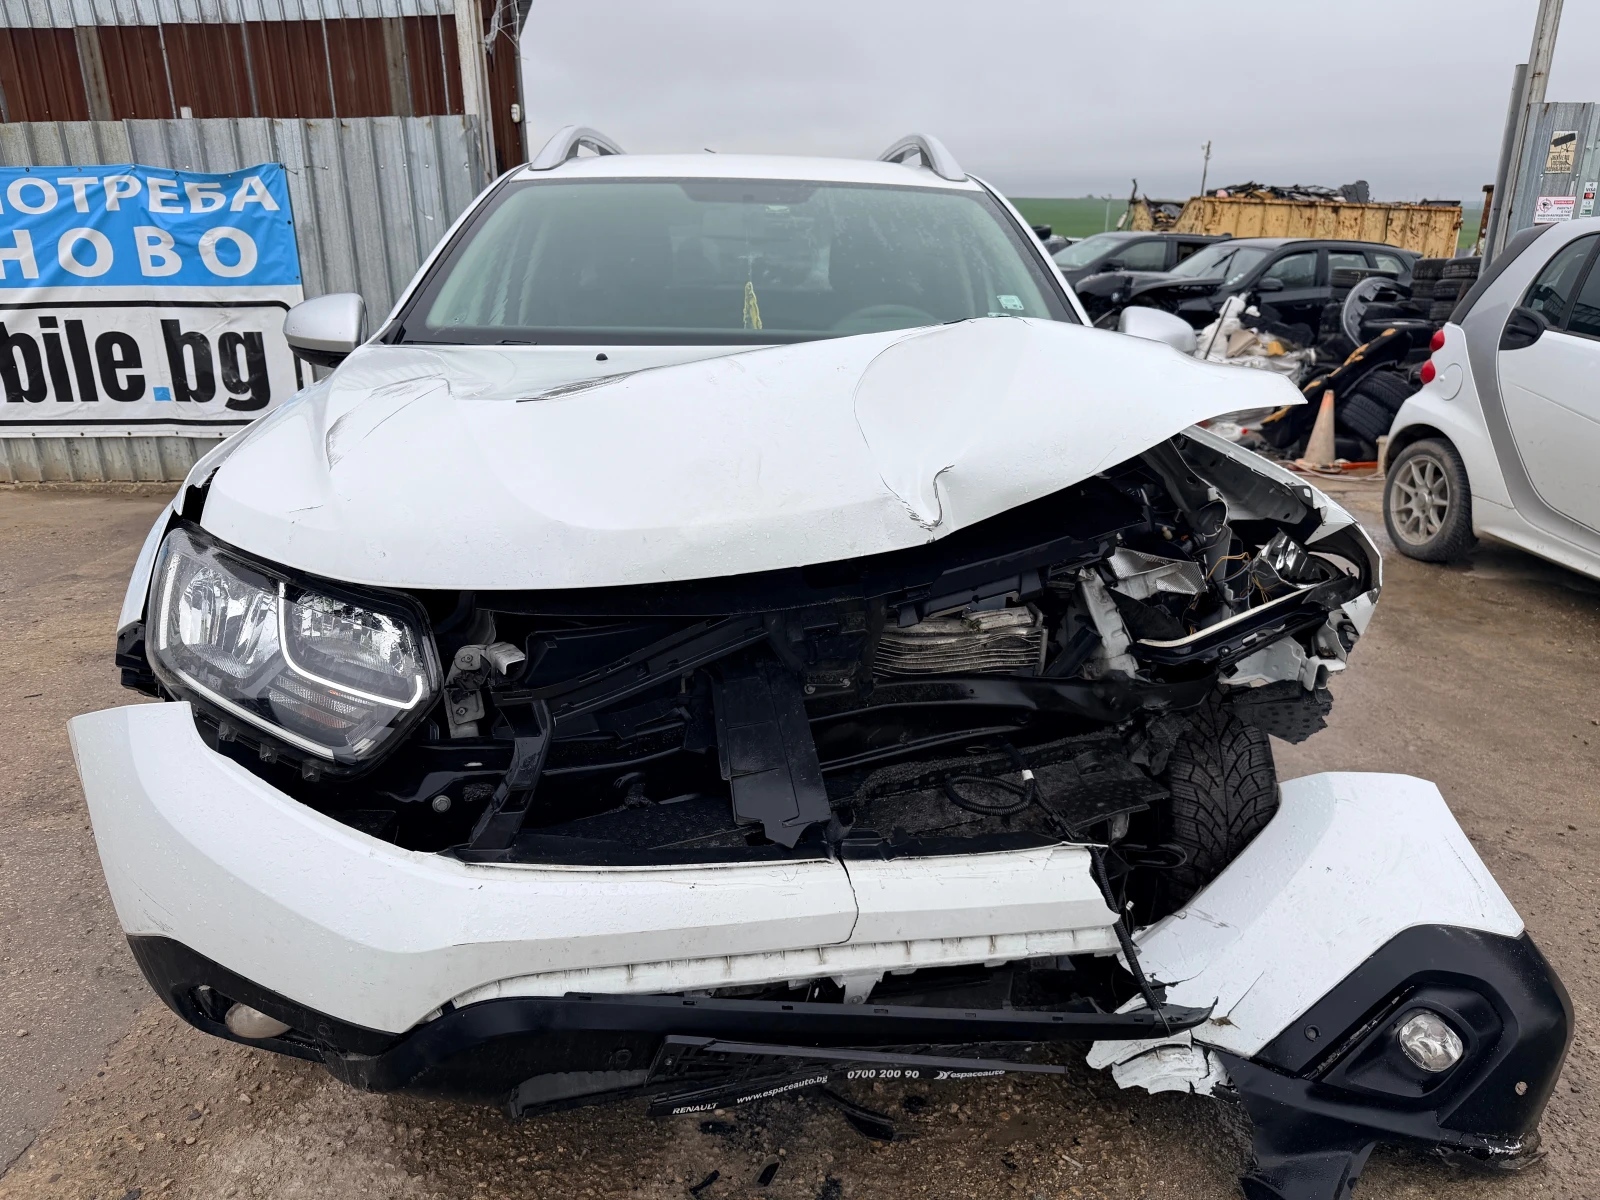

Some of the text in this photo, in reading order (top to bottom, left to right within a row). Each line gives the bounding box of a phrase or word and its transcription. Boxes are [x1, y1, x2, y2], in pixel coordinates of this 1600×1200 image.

[0, 175, 280, 215] ОТРЕБА
[847, 1069, 1006, 1079] 0700 200 90 espaceauto
[736, 1074, 828, 1104] www.espaceauto.bg
[672, 1102, 718, 1115] RENAULT
